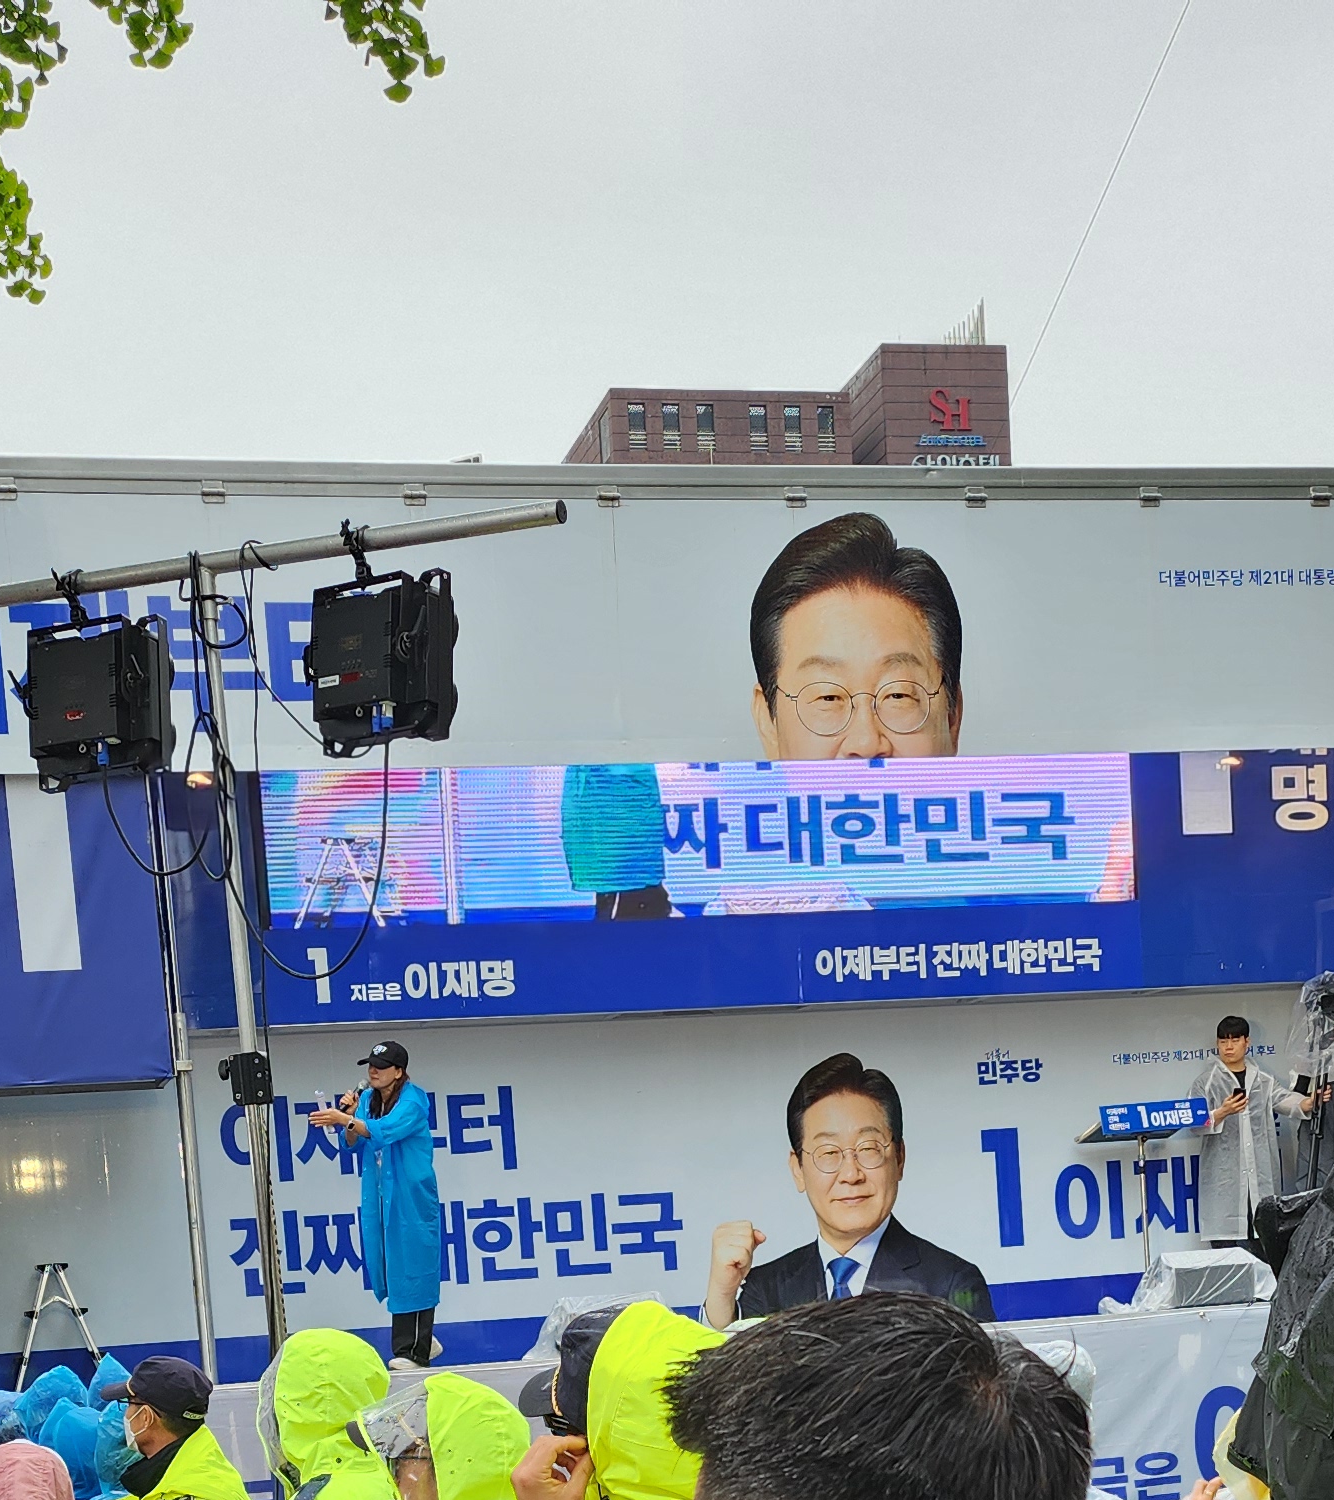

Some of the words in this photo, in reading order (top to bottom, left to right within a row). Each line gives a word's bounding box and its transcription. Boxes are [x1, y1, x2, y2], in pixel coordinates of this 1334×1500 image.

[1159, 569, 1244, 587] 더불어민주당
[1248, 569, 1294, 586] 제21대
[744, 790, 1076, 866] 대한민국
[307, 947, 331, 1004] 1
[350, 982, 402, 1002] 지금은
[404, 959, 516, 1000] 이재명
[815, 943, 927, 983] 이제부터
[931, 940, 988, 978] 진짜
[993, 938, 1102, 975] 대한민국
[977, 1057, 1044, 1085] 민주당
[1112, 1049, 1170, 1065] 더불어민주당
[1172, 1048, 1204, 1062] 제21대
[220, 1085, 518, 1183] 이제터
[1136, 1105, 1149, 1129] 1
[1150, 1108, 1194, 1127] 이재명
[981, 1127, 1025, 1247] 1
[1054, 1154, 1200, 1240] 이재
